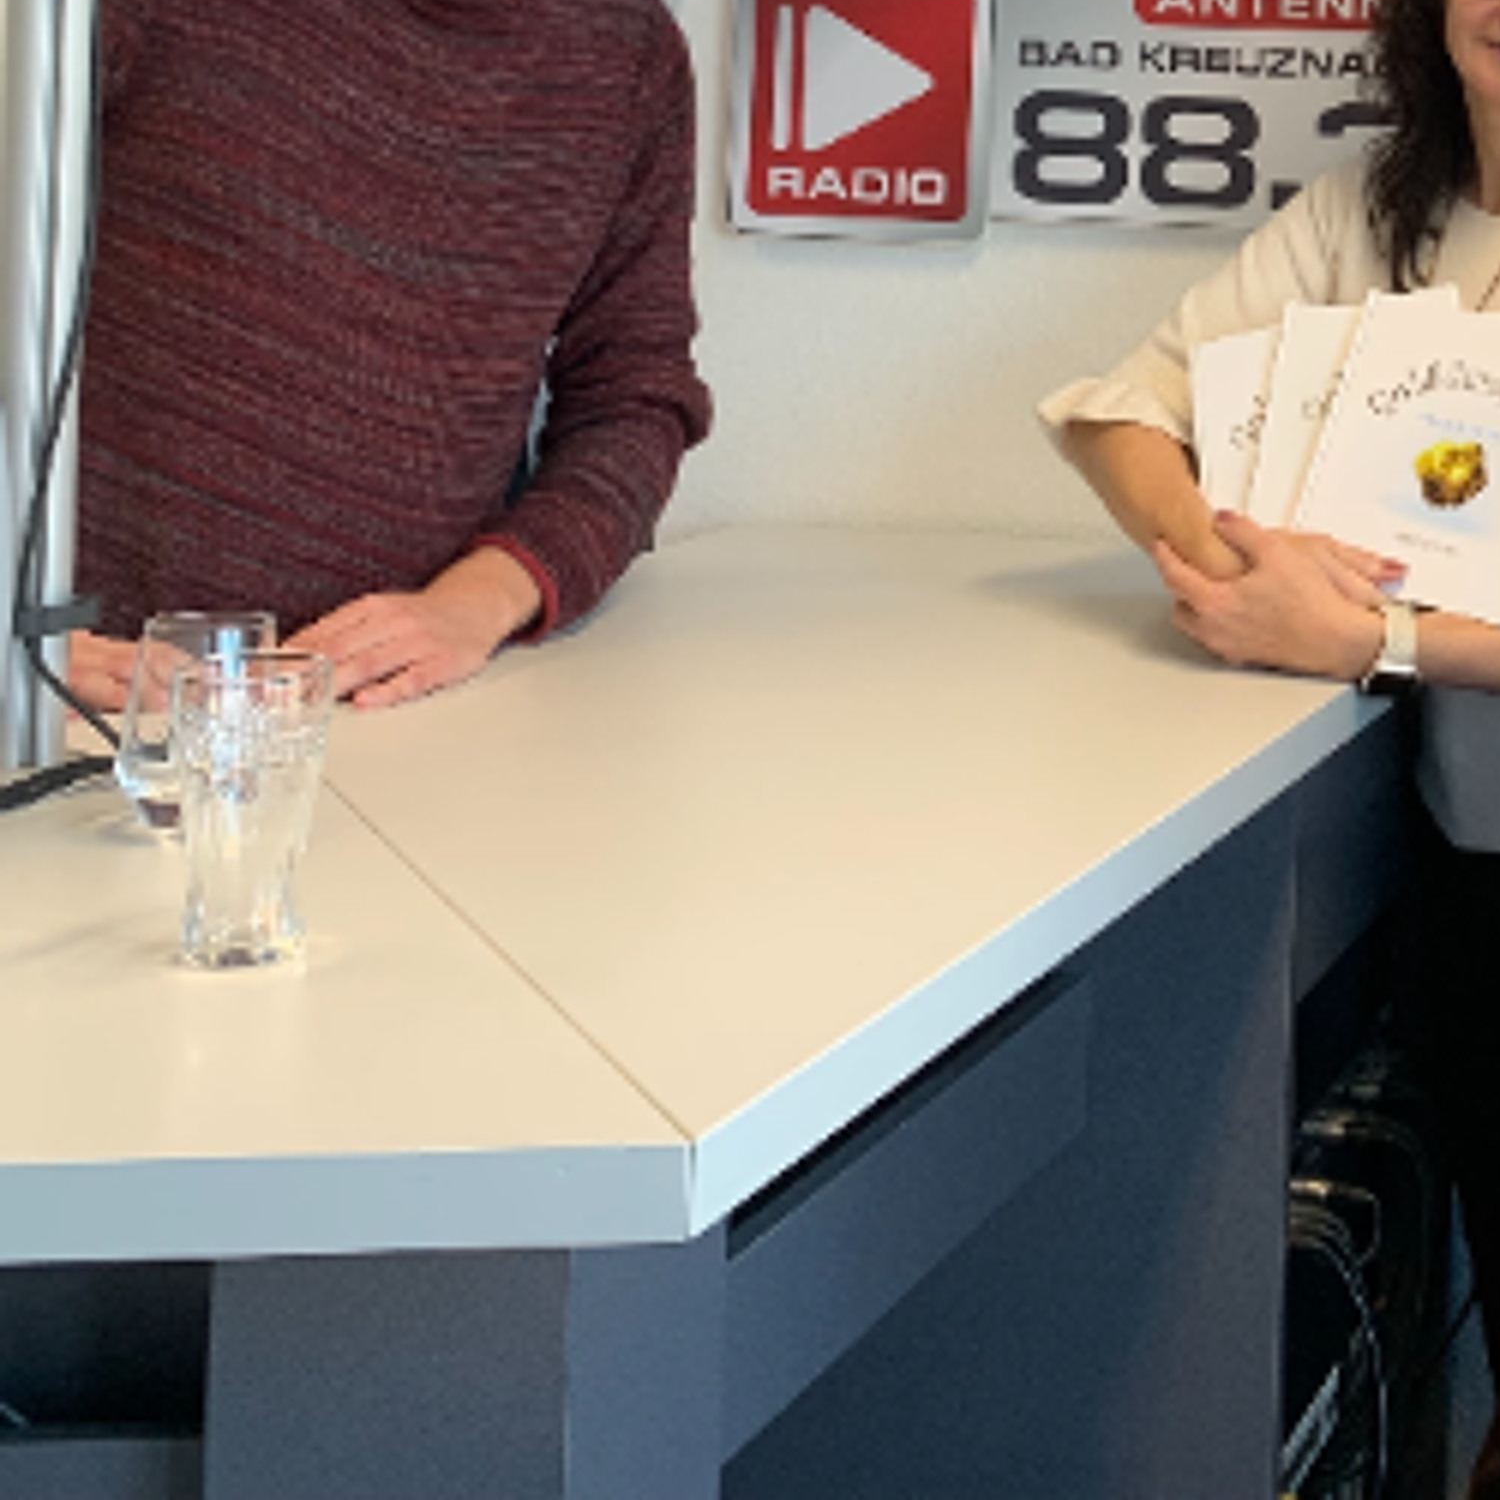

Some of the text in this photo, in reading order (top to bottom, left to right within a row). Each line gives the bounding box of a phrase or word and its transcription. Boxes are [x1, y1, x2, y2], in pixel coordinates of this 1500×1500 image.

[1019, 40, 1388, 79] BAD KREUZNA
[766, 166, 947, 203] RADIO
